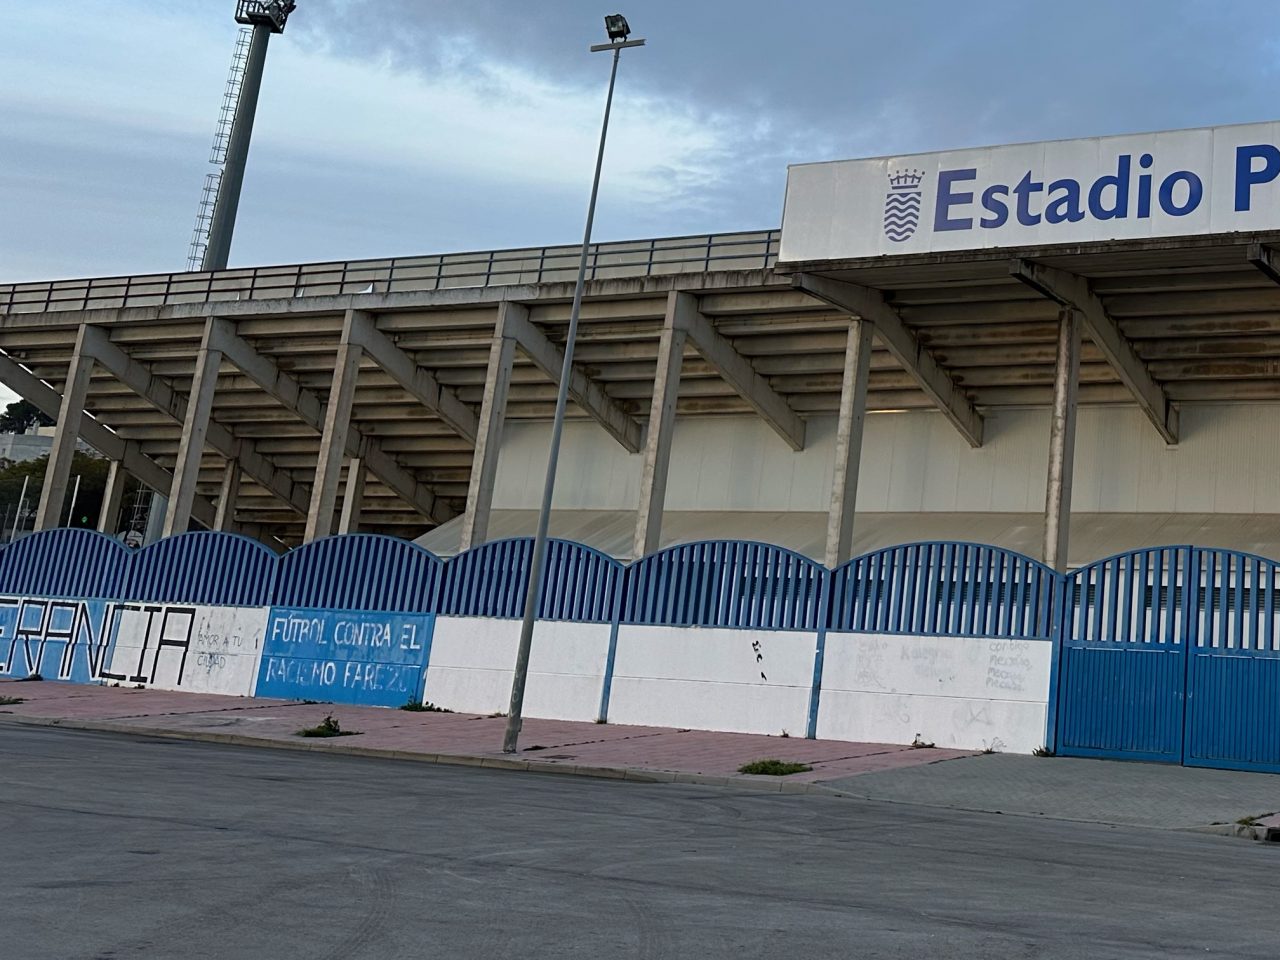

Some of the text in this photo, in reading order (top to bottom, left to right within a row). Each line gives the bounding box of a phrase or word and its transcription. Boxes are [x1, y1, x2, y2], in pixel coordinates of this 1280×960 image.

[933, 154, 1203, 232] Estadio
[334, 620, 391, 648] CONTRA
[400, 623, 426, 650] EL
